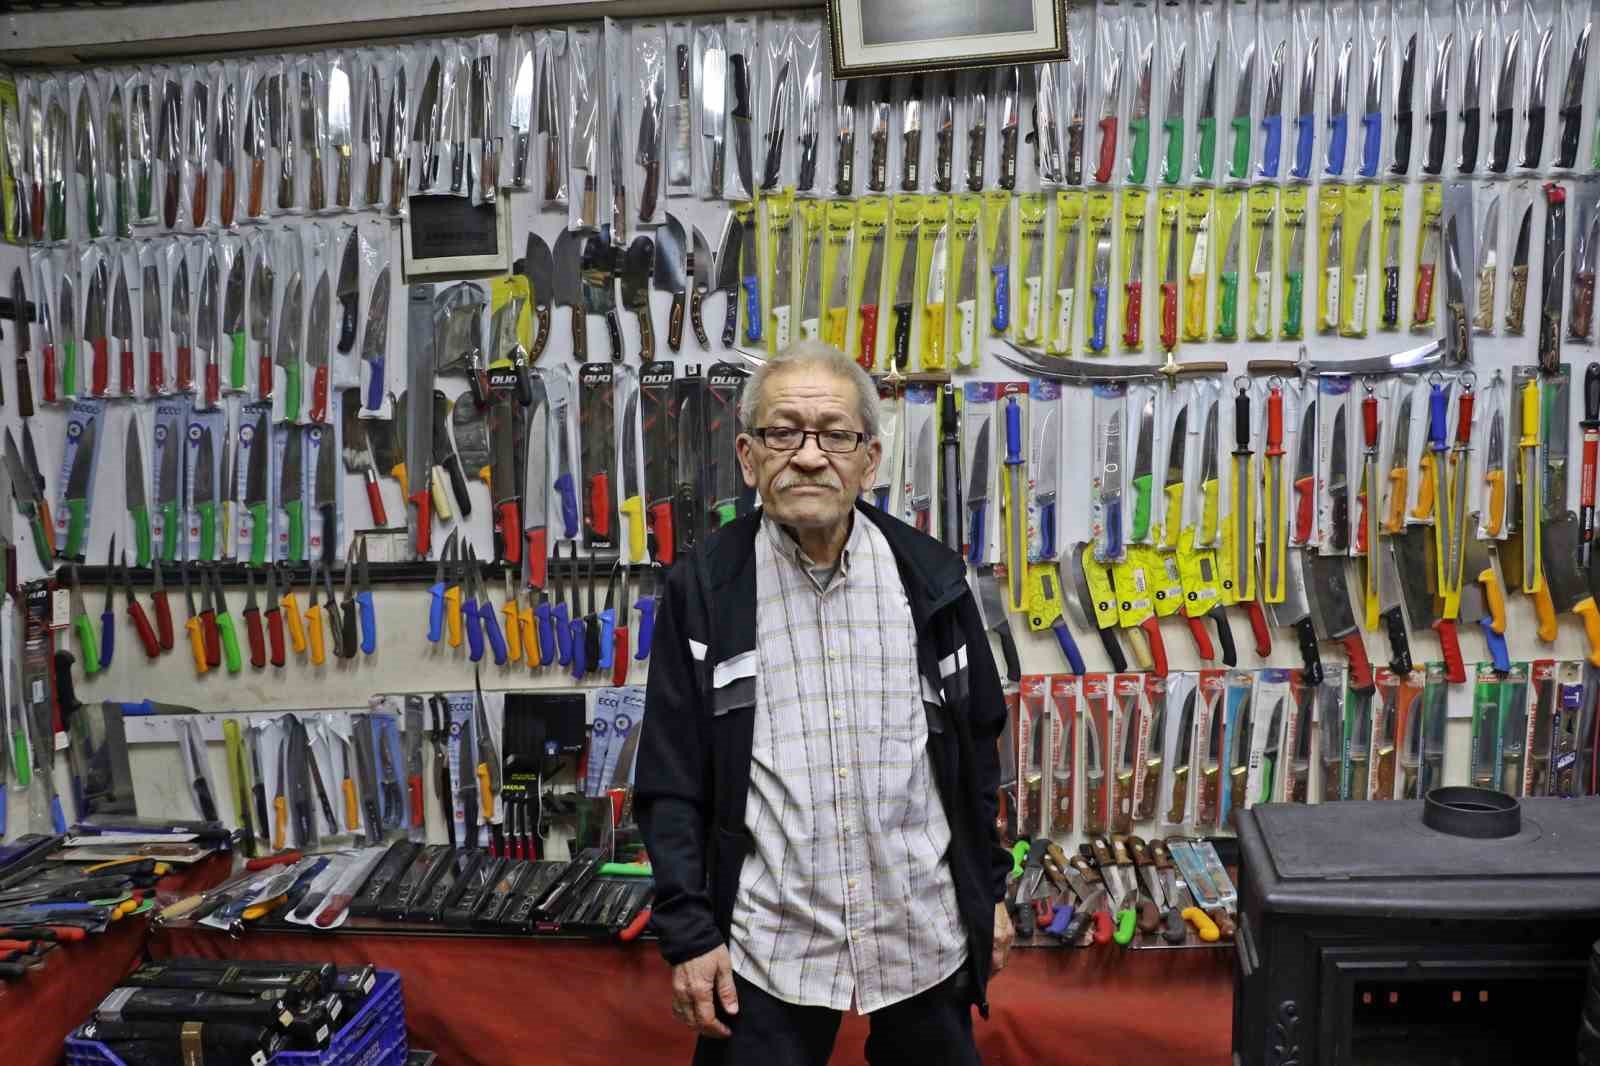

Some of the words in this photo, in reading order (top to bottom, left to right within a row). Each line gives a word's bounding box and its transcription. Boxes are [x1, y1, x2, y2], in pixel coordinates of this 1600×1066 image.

[490, 375, 518, 385] DUO
[584, 374, 611, 384] DUO
[642, 374, 673, 384] DUO
[710, 375, 741, 385] DUO
[448, 703, 474, 712] ECCO
